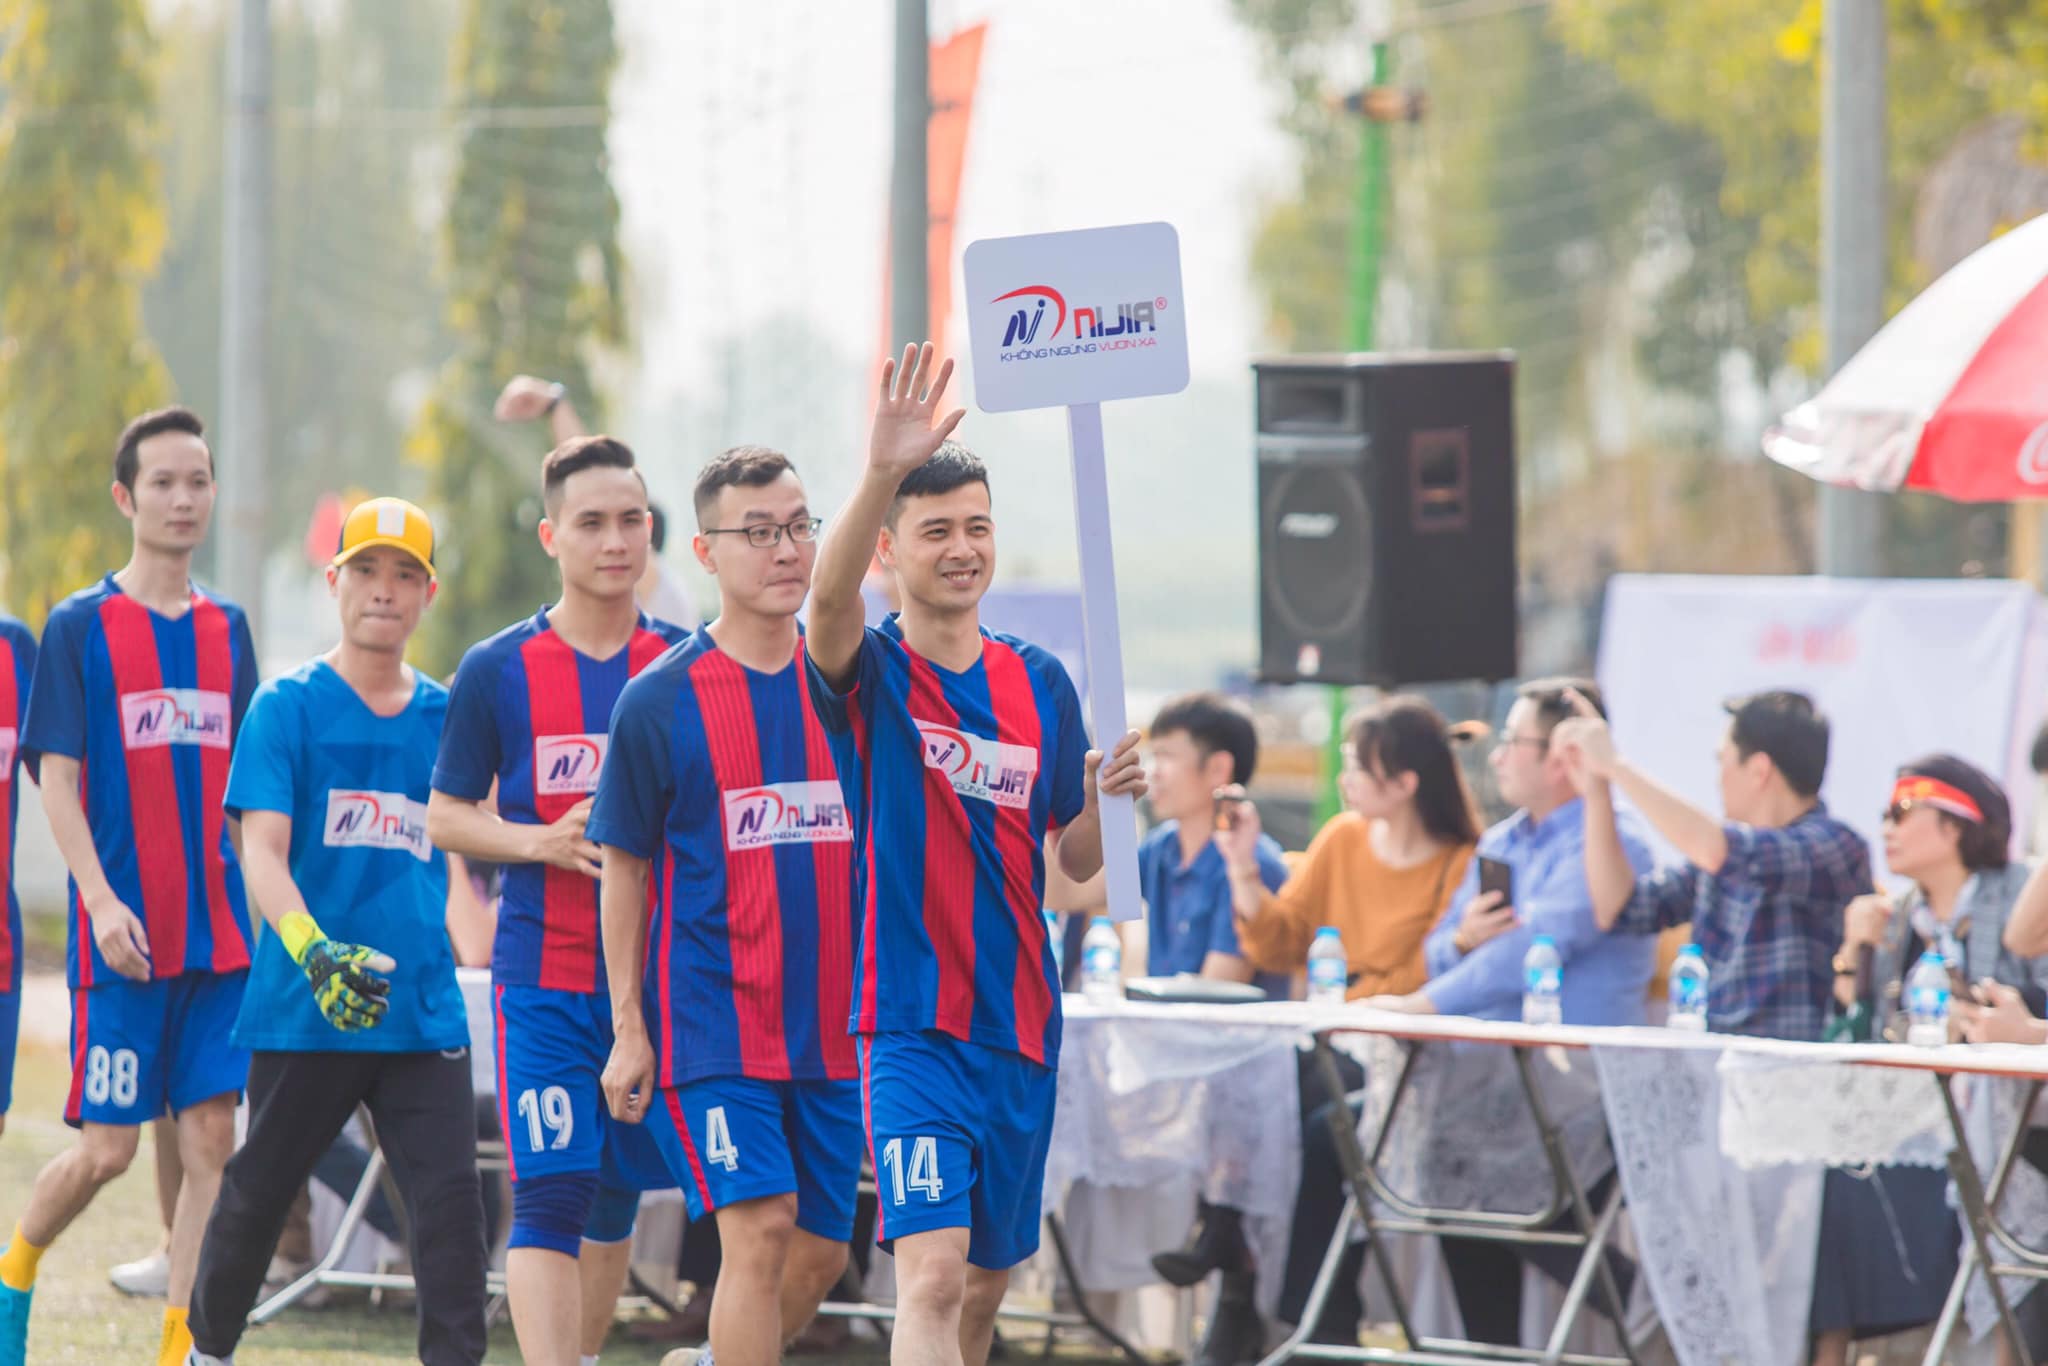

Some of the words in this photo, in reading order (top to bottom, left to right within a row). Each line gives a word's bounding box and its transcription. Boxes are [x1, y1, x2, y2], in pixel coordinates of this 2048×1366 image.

[85, 1045, 139, 1109] 88
[517, 1085, 574, 1152] 19
[706, 1105, 739, 1172] 4
[883, 1136, 943, 1206] 14
